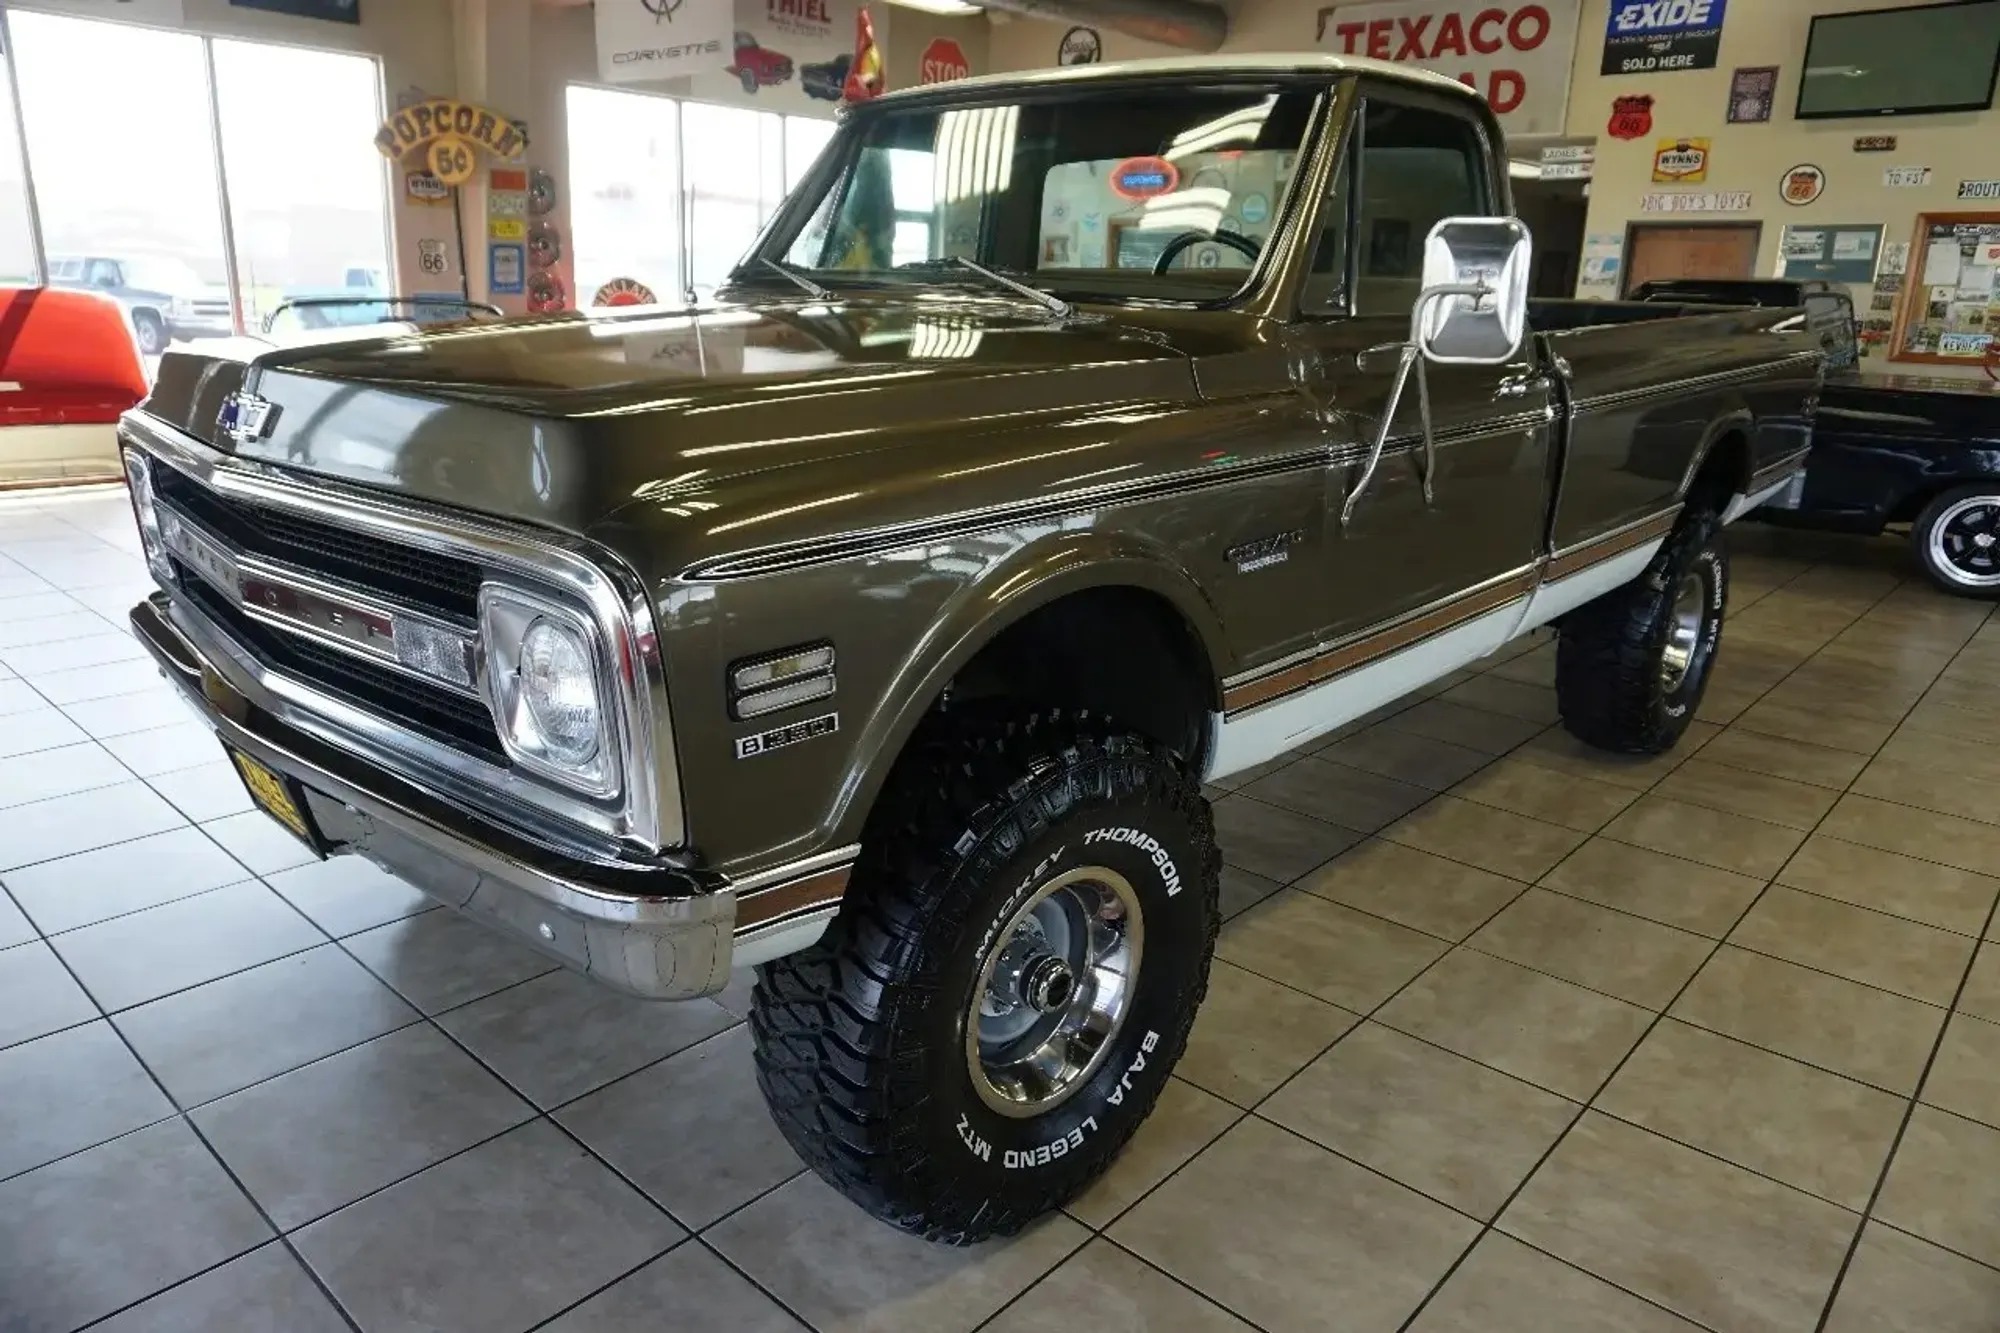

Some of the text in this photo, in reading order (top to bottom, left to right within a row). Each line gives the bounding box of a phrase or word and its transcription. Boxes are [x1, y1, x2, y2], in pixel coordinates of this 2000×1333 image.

[1615, 0, 1713, 31] EXIDE
[1336, 5, 1550, 61] TEXACO
[612, 40, 721, 64] CORVETTE
[1622, 54, 1695, 71] SOLD HERE
[924, 60, 968, 85] STOP
[375, 105, 520, 157] POPCORN
[1618, 116, 1641, 132] 66
[1543, 149, 1578, 159] LADIES
[1541, 166, 1576, 176] MEN
[1966, 182, 2000, 197] ROUT
[423, 253, 444, 270] 66
[185, 536, 380, 639] CHEVOET
[975, 826, 1182, 960] MICKEY THOMPSON
[956, 1030, 1160, 1169] BAJA LEGEND MTZ
